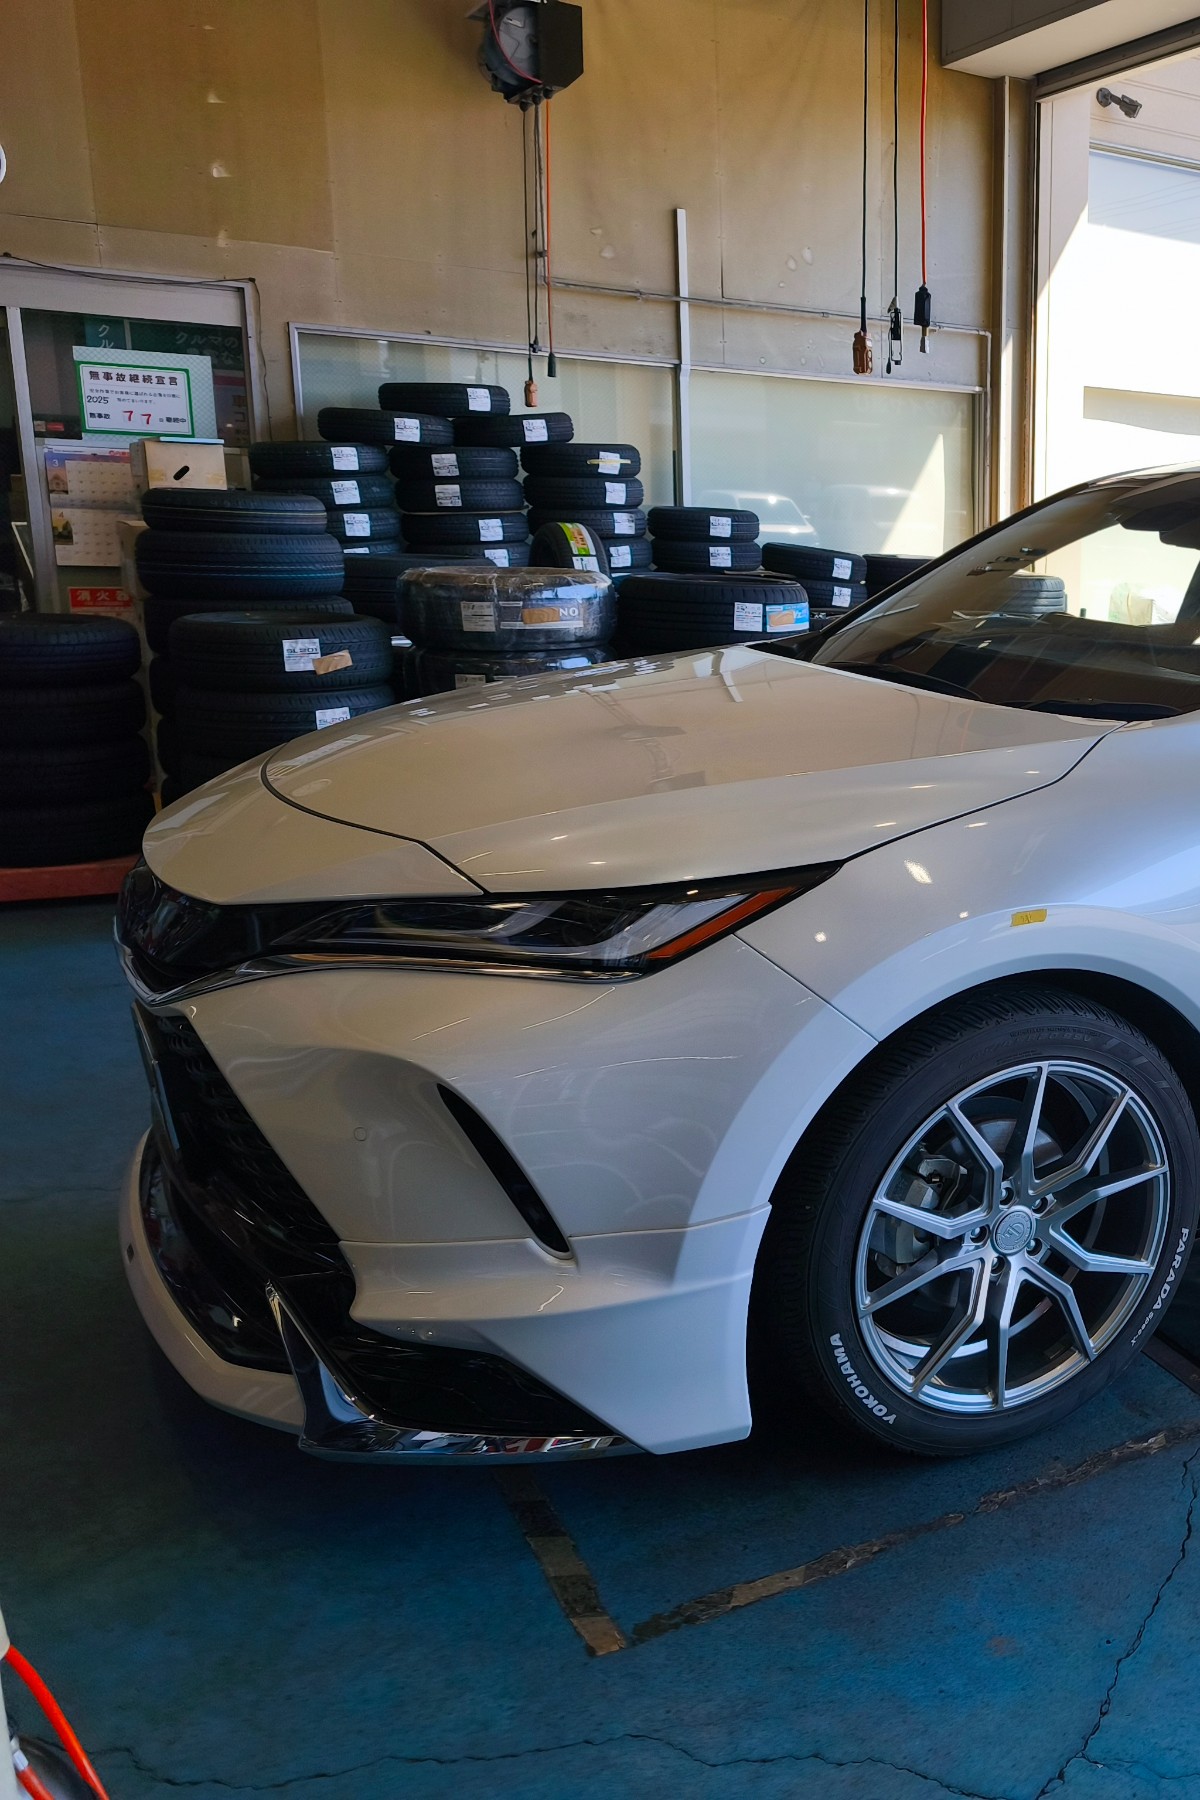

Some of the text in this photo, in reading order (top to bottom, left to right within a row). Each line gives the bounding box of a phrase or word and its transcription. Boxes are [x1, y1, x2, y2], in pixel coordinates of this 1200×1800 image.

[86, 395, 110, 405] 2025
[89, 370, 179, 386] 無事故継続宣言
[1152, 1227, 1190, 1310] PARADA
[829, 1332, 897, 1425] YOKOHAMA
